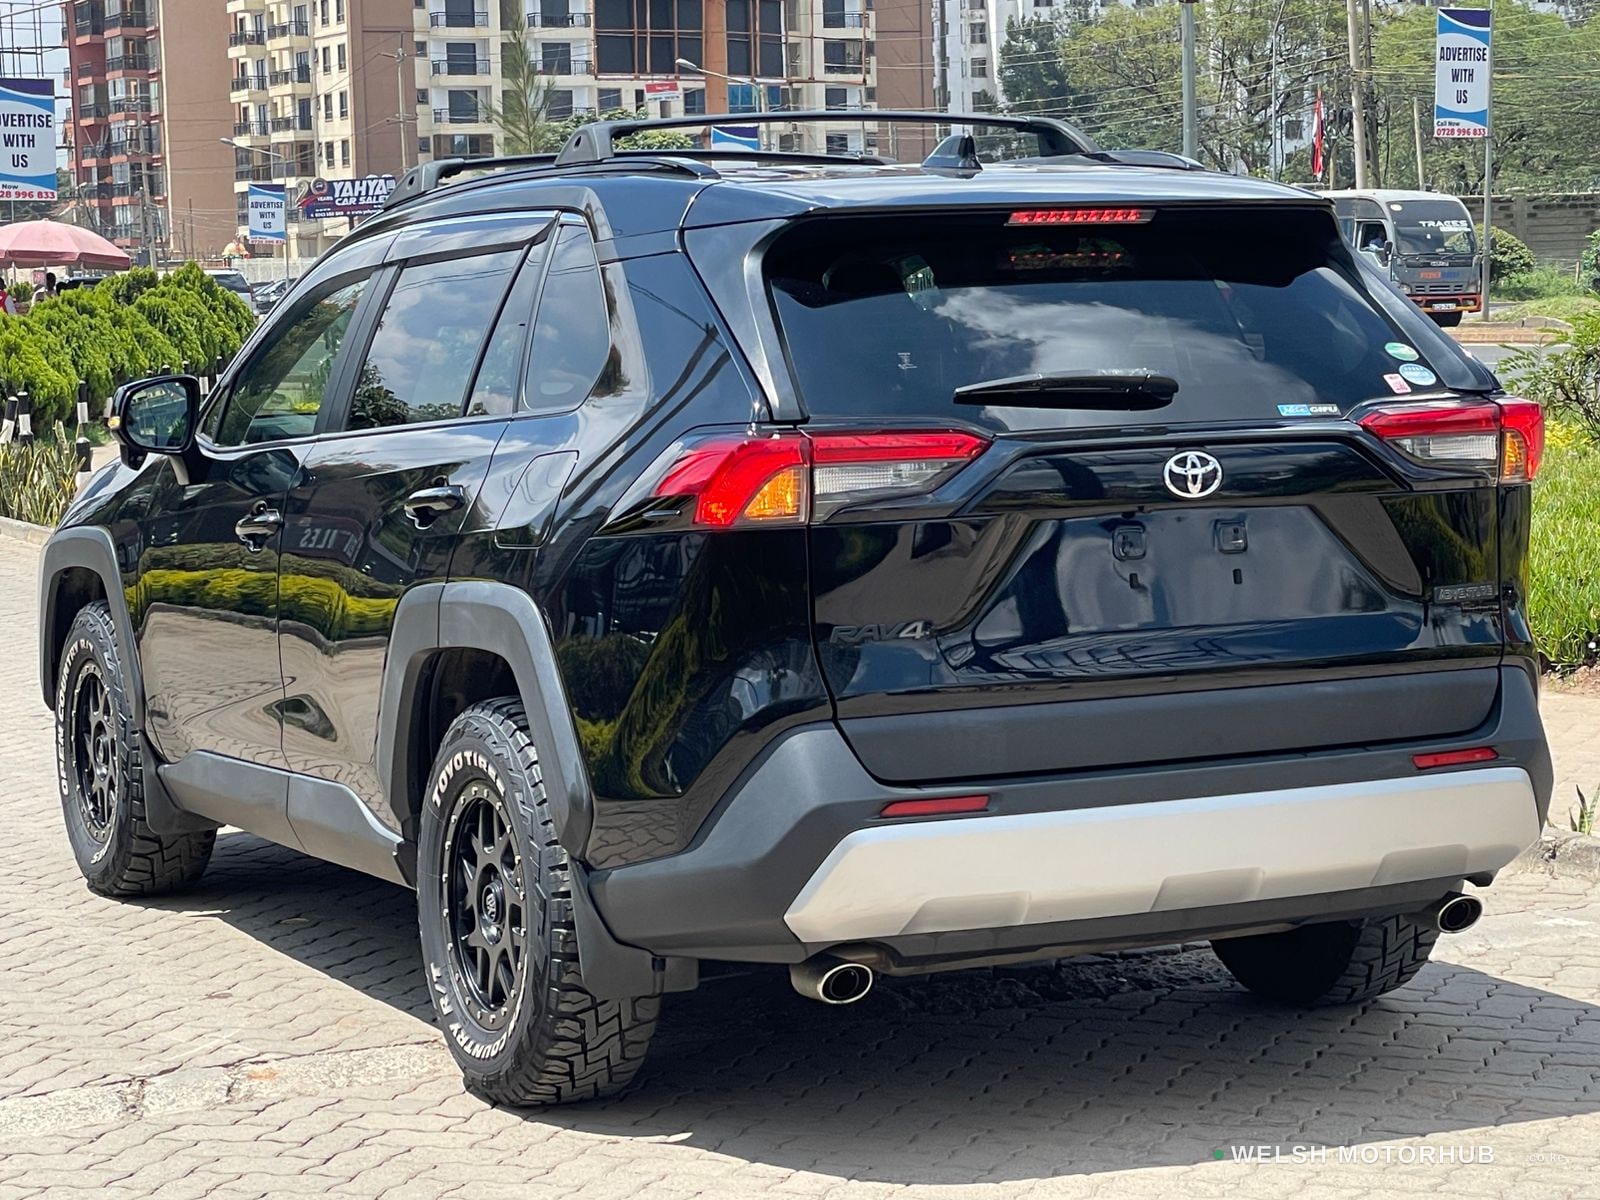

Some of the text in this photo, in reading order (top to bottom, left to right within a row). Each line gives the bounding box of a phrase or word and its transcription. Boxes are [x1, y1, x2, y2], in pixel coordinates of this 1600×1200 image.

[1440, 47, 1487, 62] ADVERTISE
[1451, 68, 1474, 83] WITH
[1456, 89, 1468, 104] US
[0, 113, 52, 129] VERTISE
[1436, 128, 1455, 136] 0728
[3, 133, 36, 149] WITH
[11, 154, 29, 168] US
[14, 191, 34, 199] 996
[37, 191, 55, 199] 833
[333, 179, 387, 198] YAHYA
[250, 201, 284, 209] ADVERTISE
[335, 197, 356, 206] CAR
[262, 221, 272, 229] US
[829, 620, 925, 643] RAV4
[431, 751, 463, 808] TOYO
